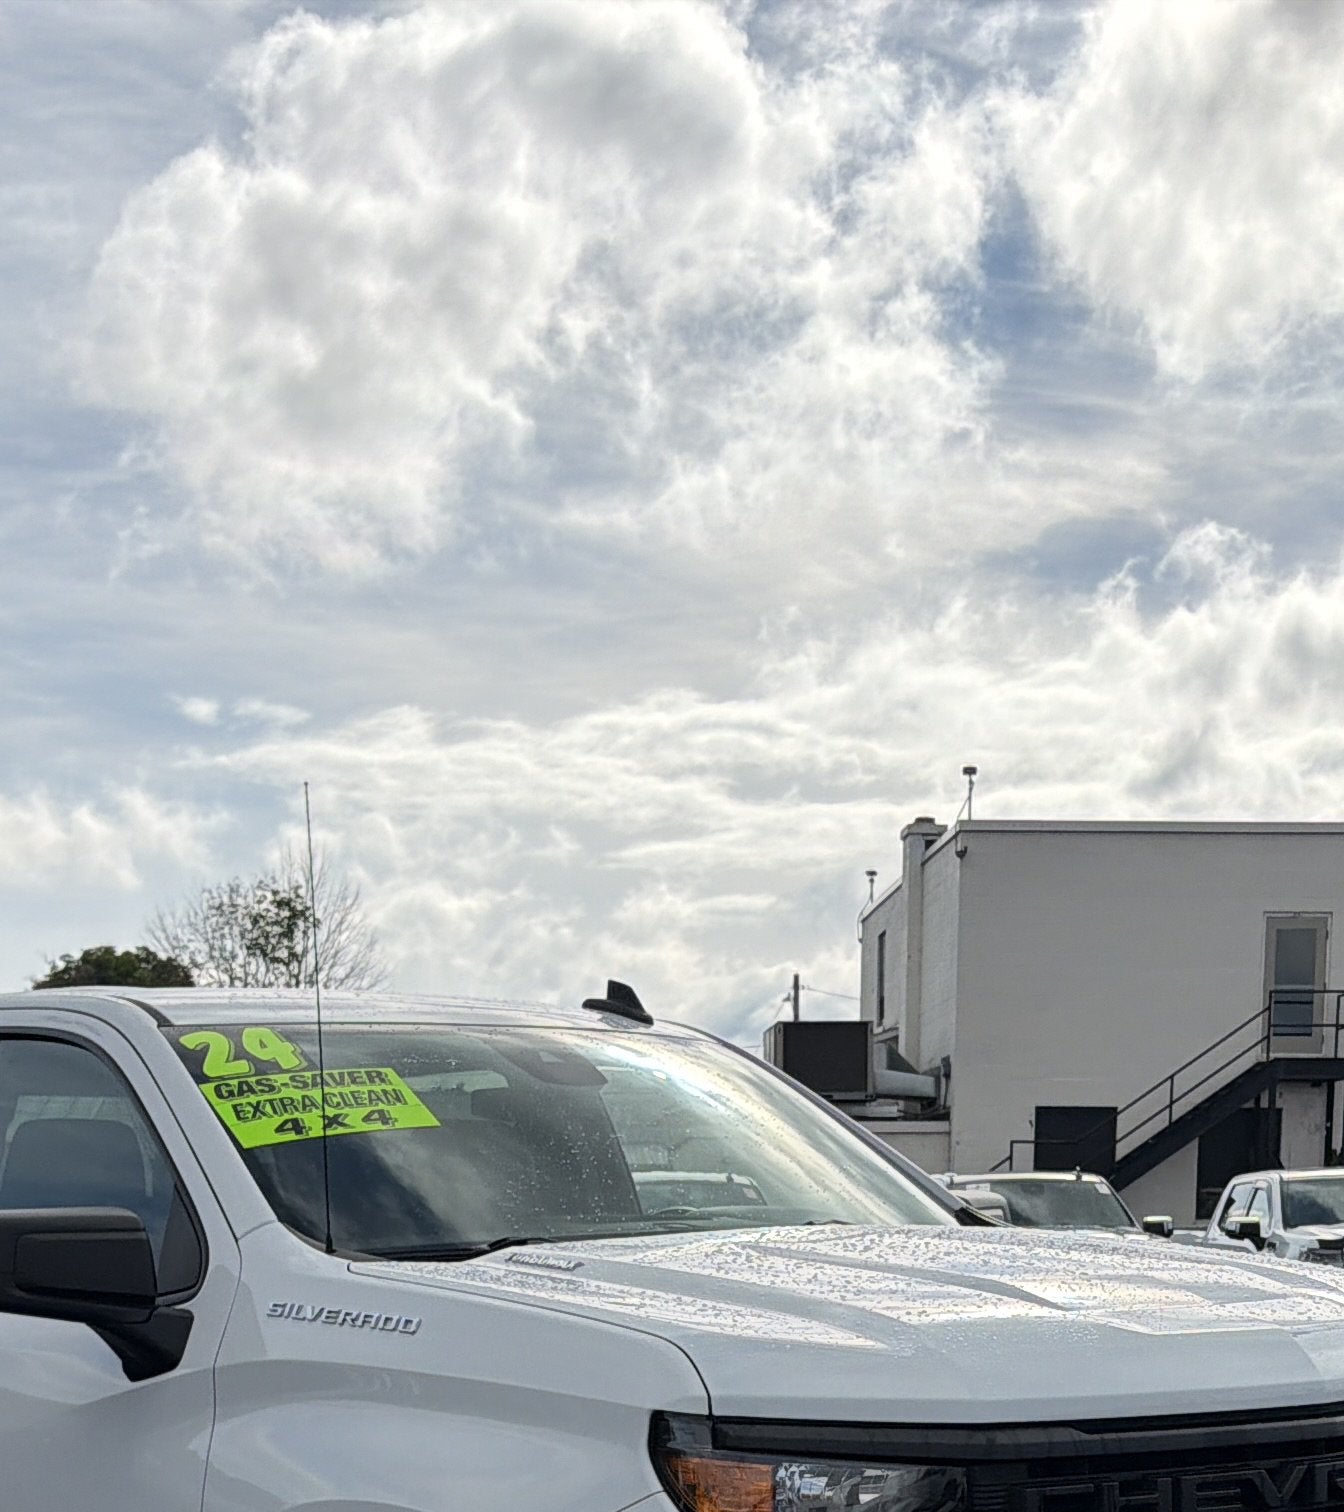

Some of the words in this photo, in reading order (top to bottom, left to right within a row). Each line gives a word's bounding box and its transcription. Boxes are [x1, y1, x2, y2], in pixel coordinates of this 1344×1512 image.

[178, 1026, 308, 1080] 24
[213, 1068, 394, 1102] GAS-SAVER
[231, 1092, 323, 1123] EXTRA
[324, 1086, 409, 1110] CLEAN
[265, 1301, 423, 1336] SILVERADO
